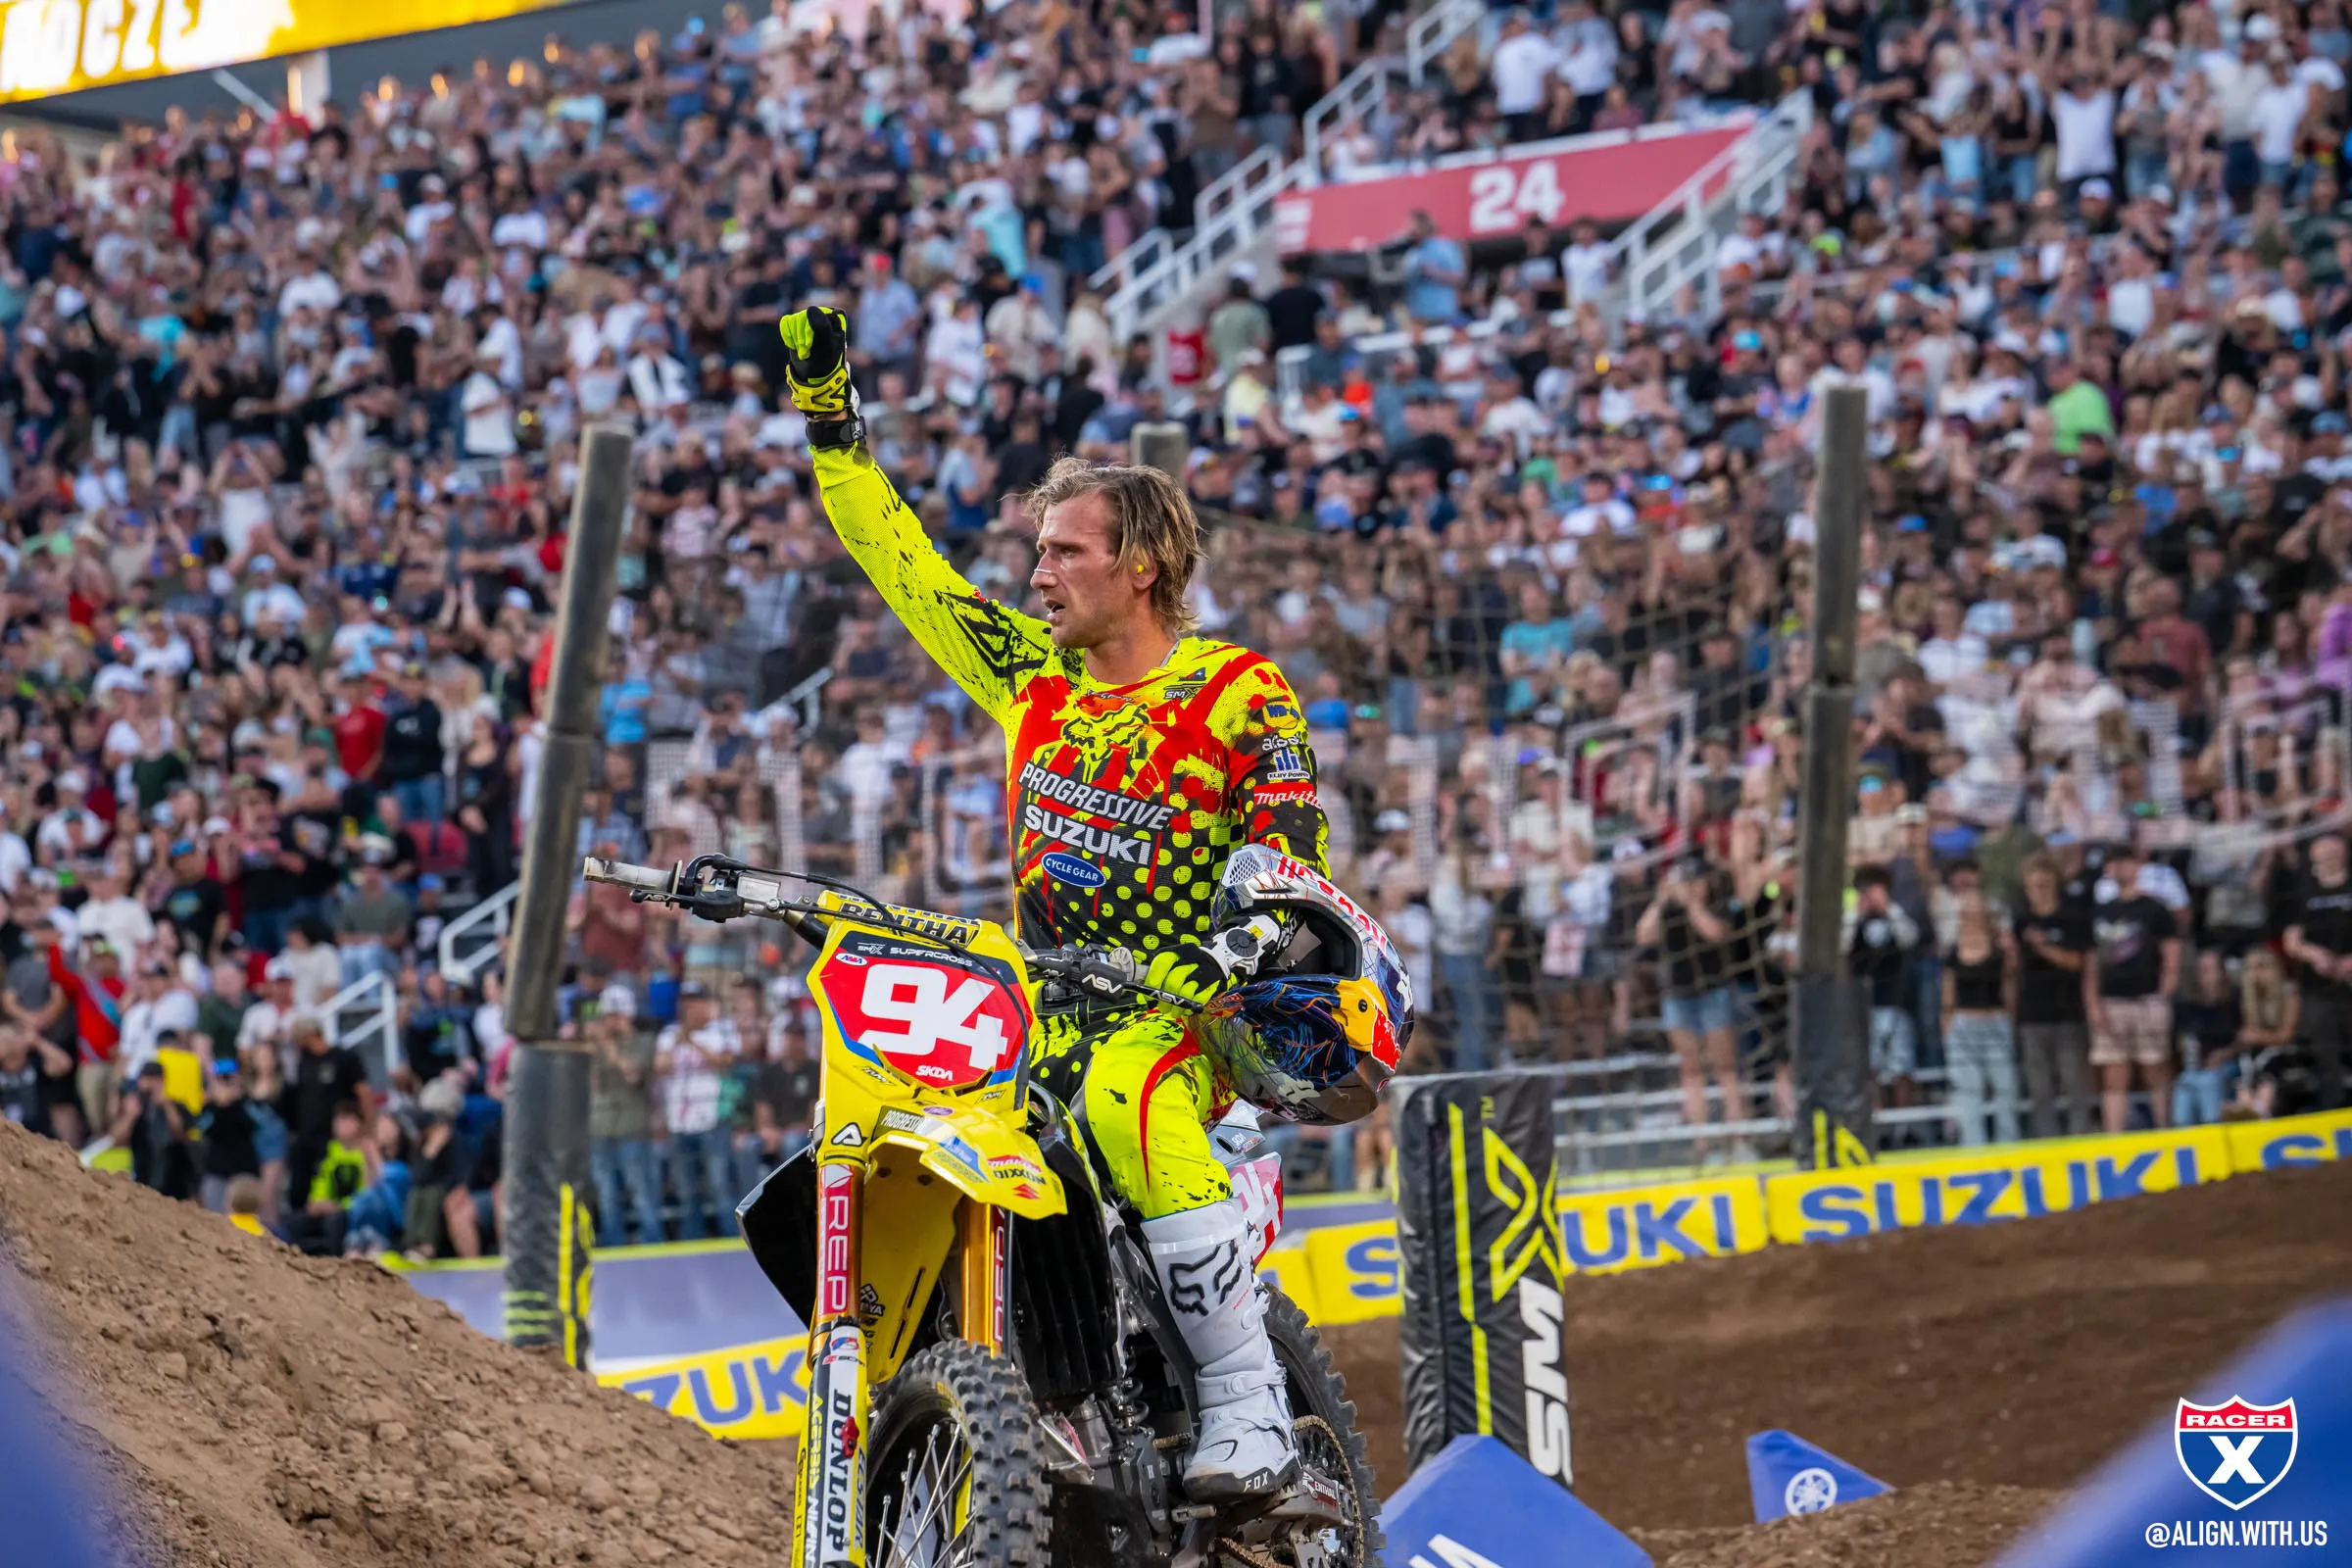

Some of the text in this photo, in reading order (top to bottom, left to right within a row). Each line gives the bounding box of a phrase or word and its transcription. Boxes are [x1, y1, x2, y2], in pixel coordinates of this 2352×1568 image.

[1471, 159, 1565, 232] 24
[1164, 687, 1200, 701] SMX
[1019, 762, 1174, 830] PROGRESSIVE
[1254, 790, 1322, 809] makita
[1024, 805, 1152, 865] SUZUKI
[1045, 857, 1099, 882] CYCLE GEAR
[889, 946, 973, 968] SUPERCROSS
[1082, 973, 1122, 994] ASV
[1151, 989, 1185, 1005] ASV
[858, 963, 1008, 1070] 94
[915, 1064, 954, 1081] SKDA
[1799, 1146, 2202, 1244] SUZUKI
[827, 1195, 850, 1311] REP
[826, 1388, 852, 1552] DUNLOP
[1243, 1471, 1268, 1494] FOX
